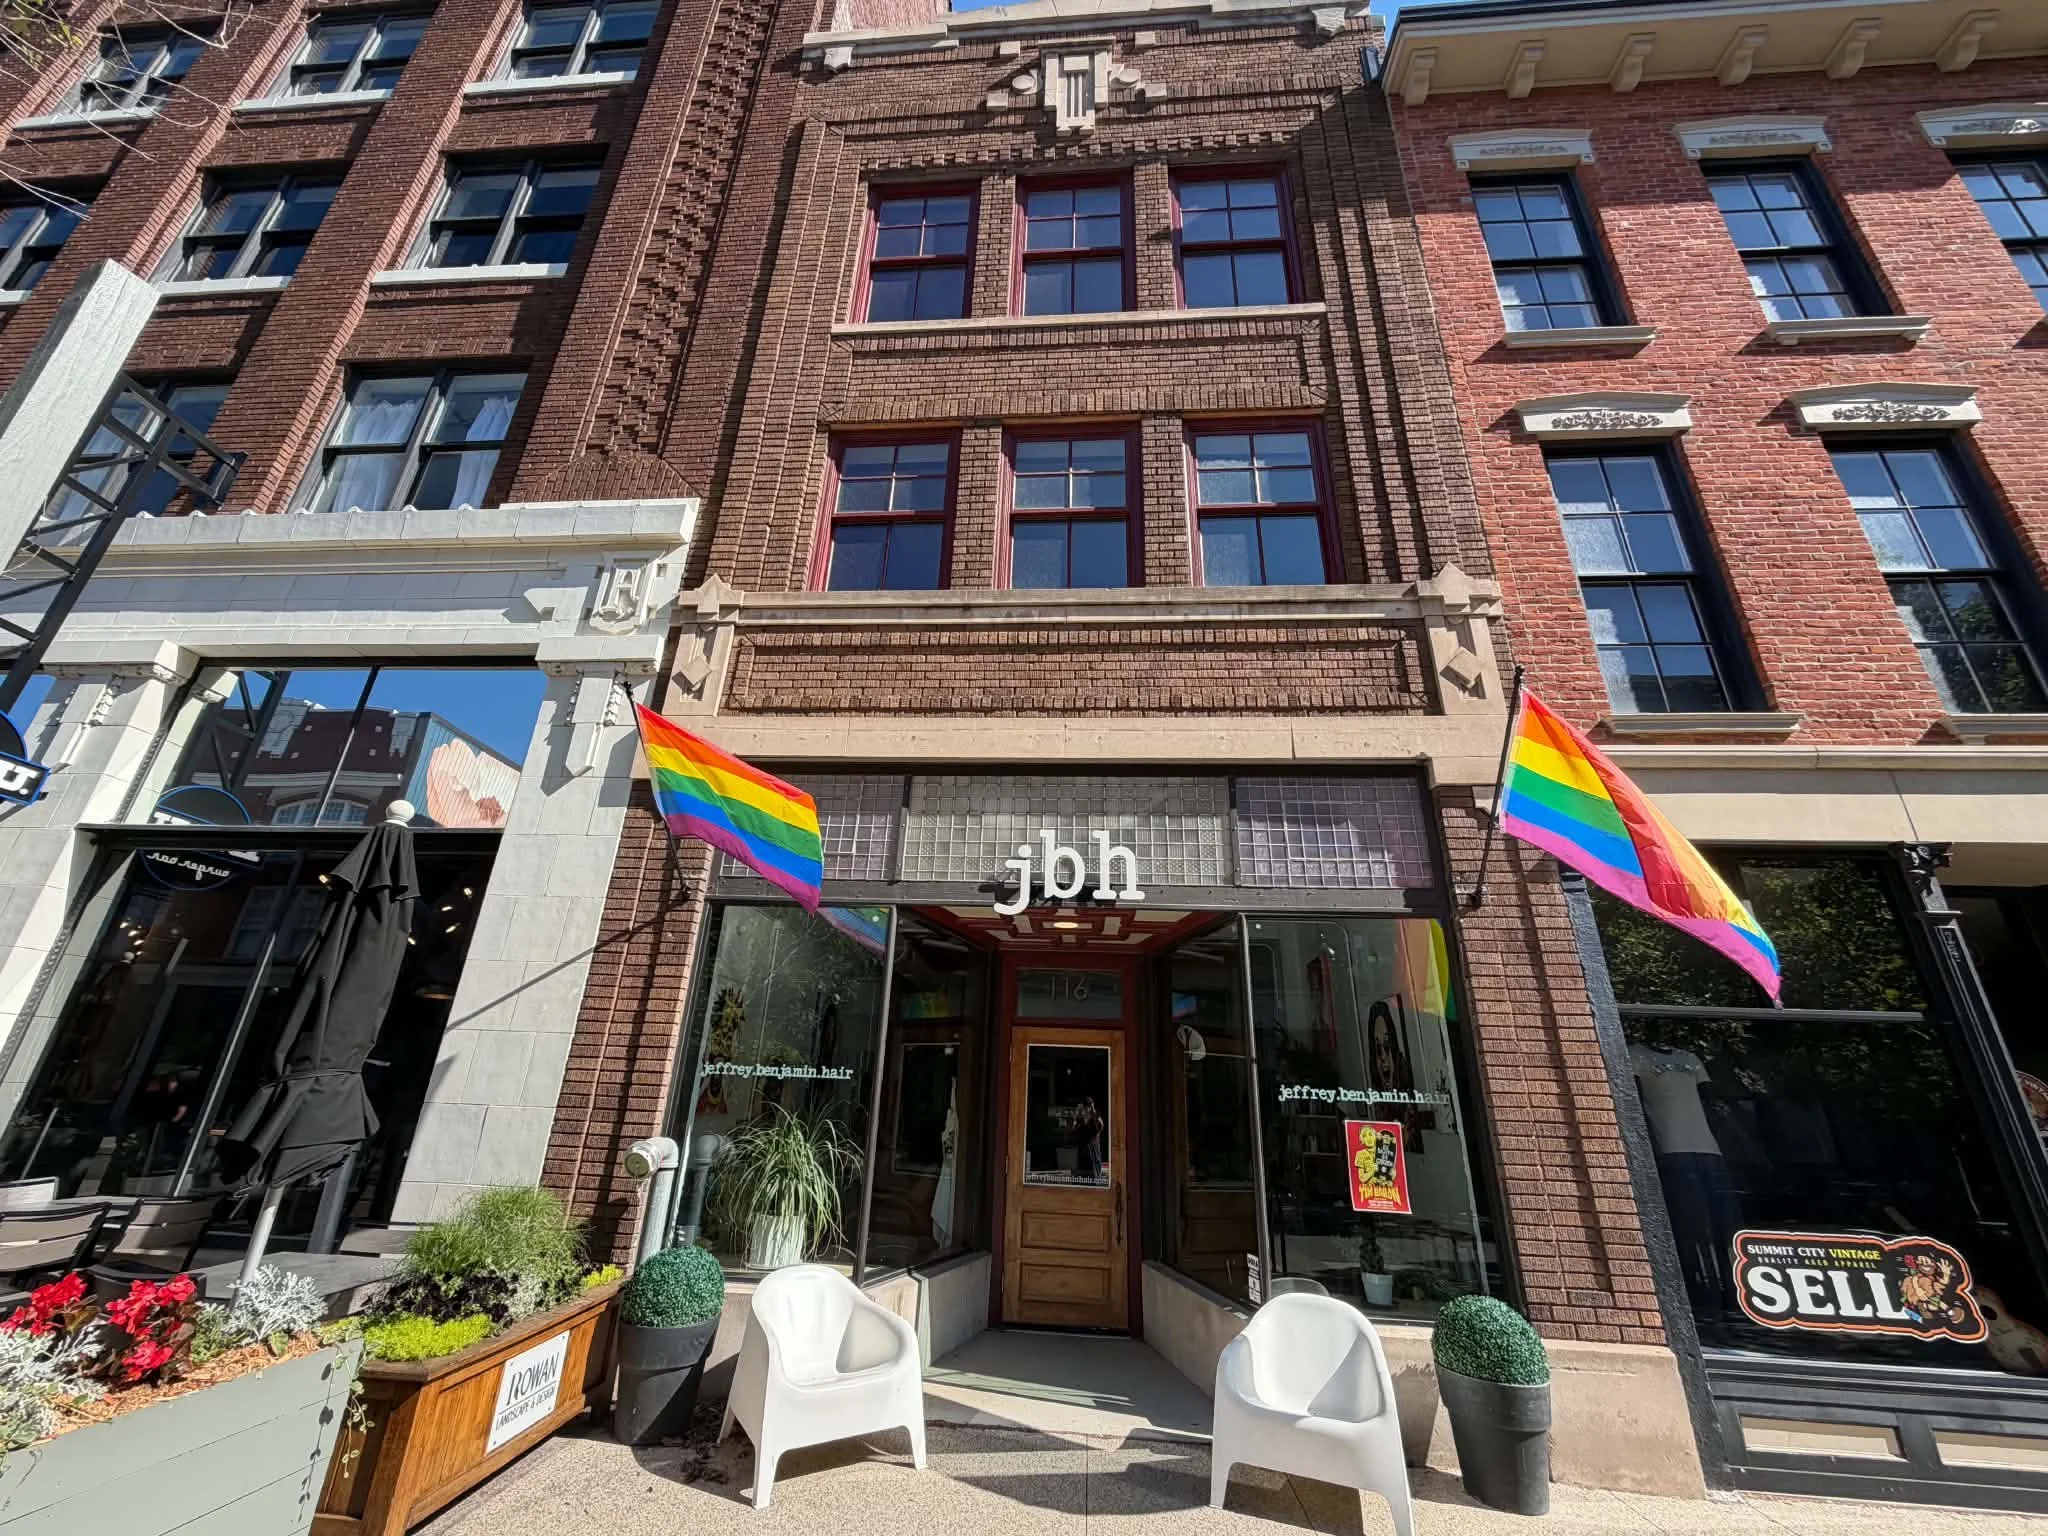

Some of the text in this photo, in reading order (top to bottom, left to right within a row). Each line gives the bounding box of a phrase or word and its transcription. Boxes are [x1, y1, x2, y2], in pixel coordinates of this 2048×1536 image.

[993, 829, 1146, 915] jbh
[1051, 975, 1088, 1001] 116
[701, 1061, 854, 1080] jeffrey.benjamin.hair
[1278, 1084, 1451, 1104] jeffrey.benjamin.hair
[1747, 1244, 1881, 1260] SUMMIT CITY VINTAGE
[1747, 1266, 1910, 1320] SELL
[506, 1352, 560, 1406] ROWAN
